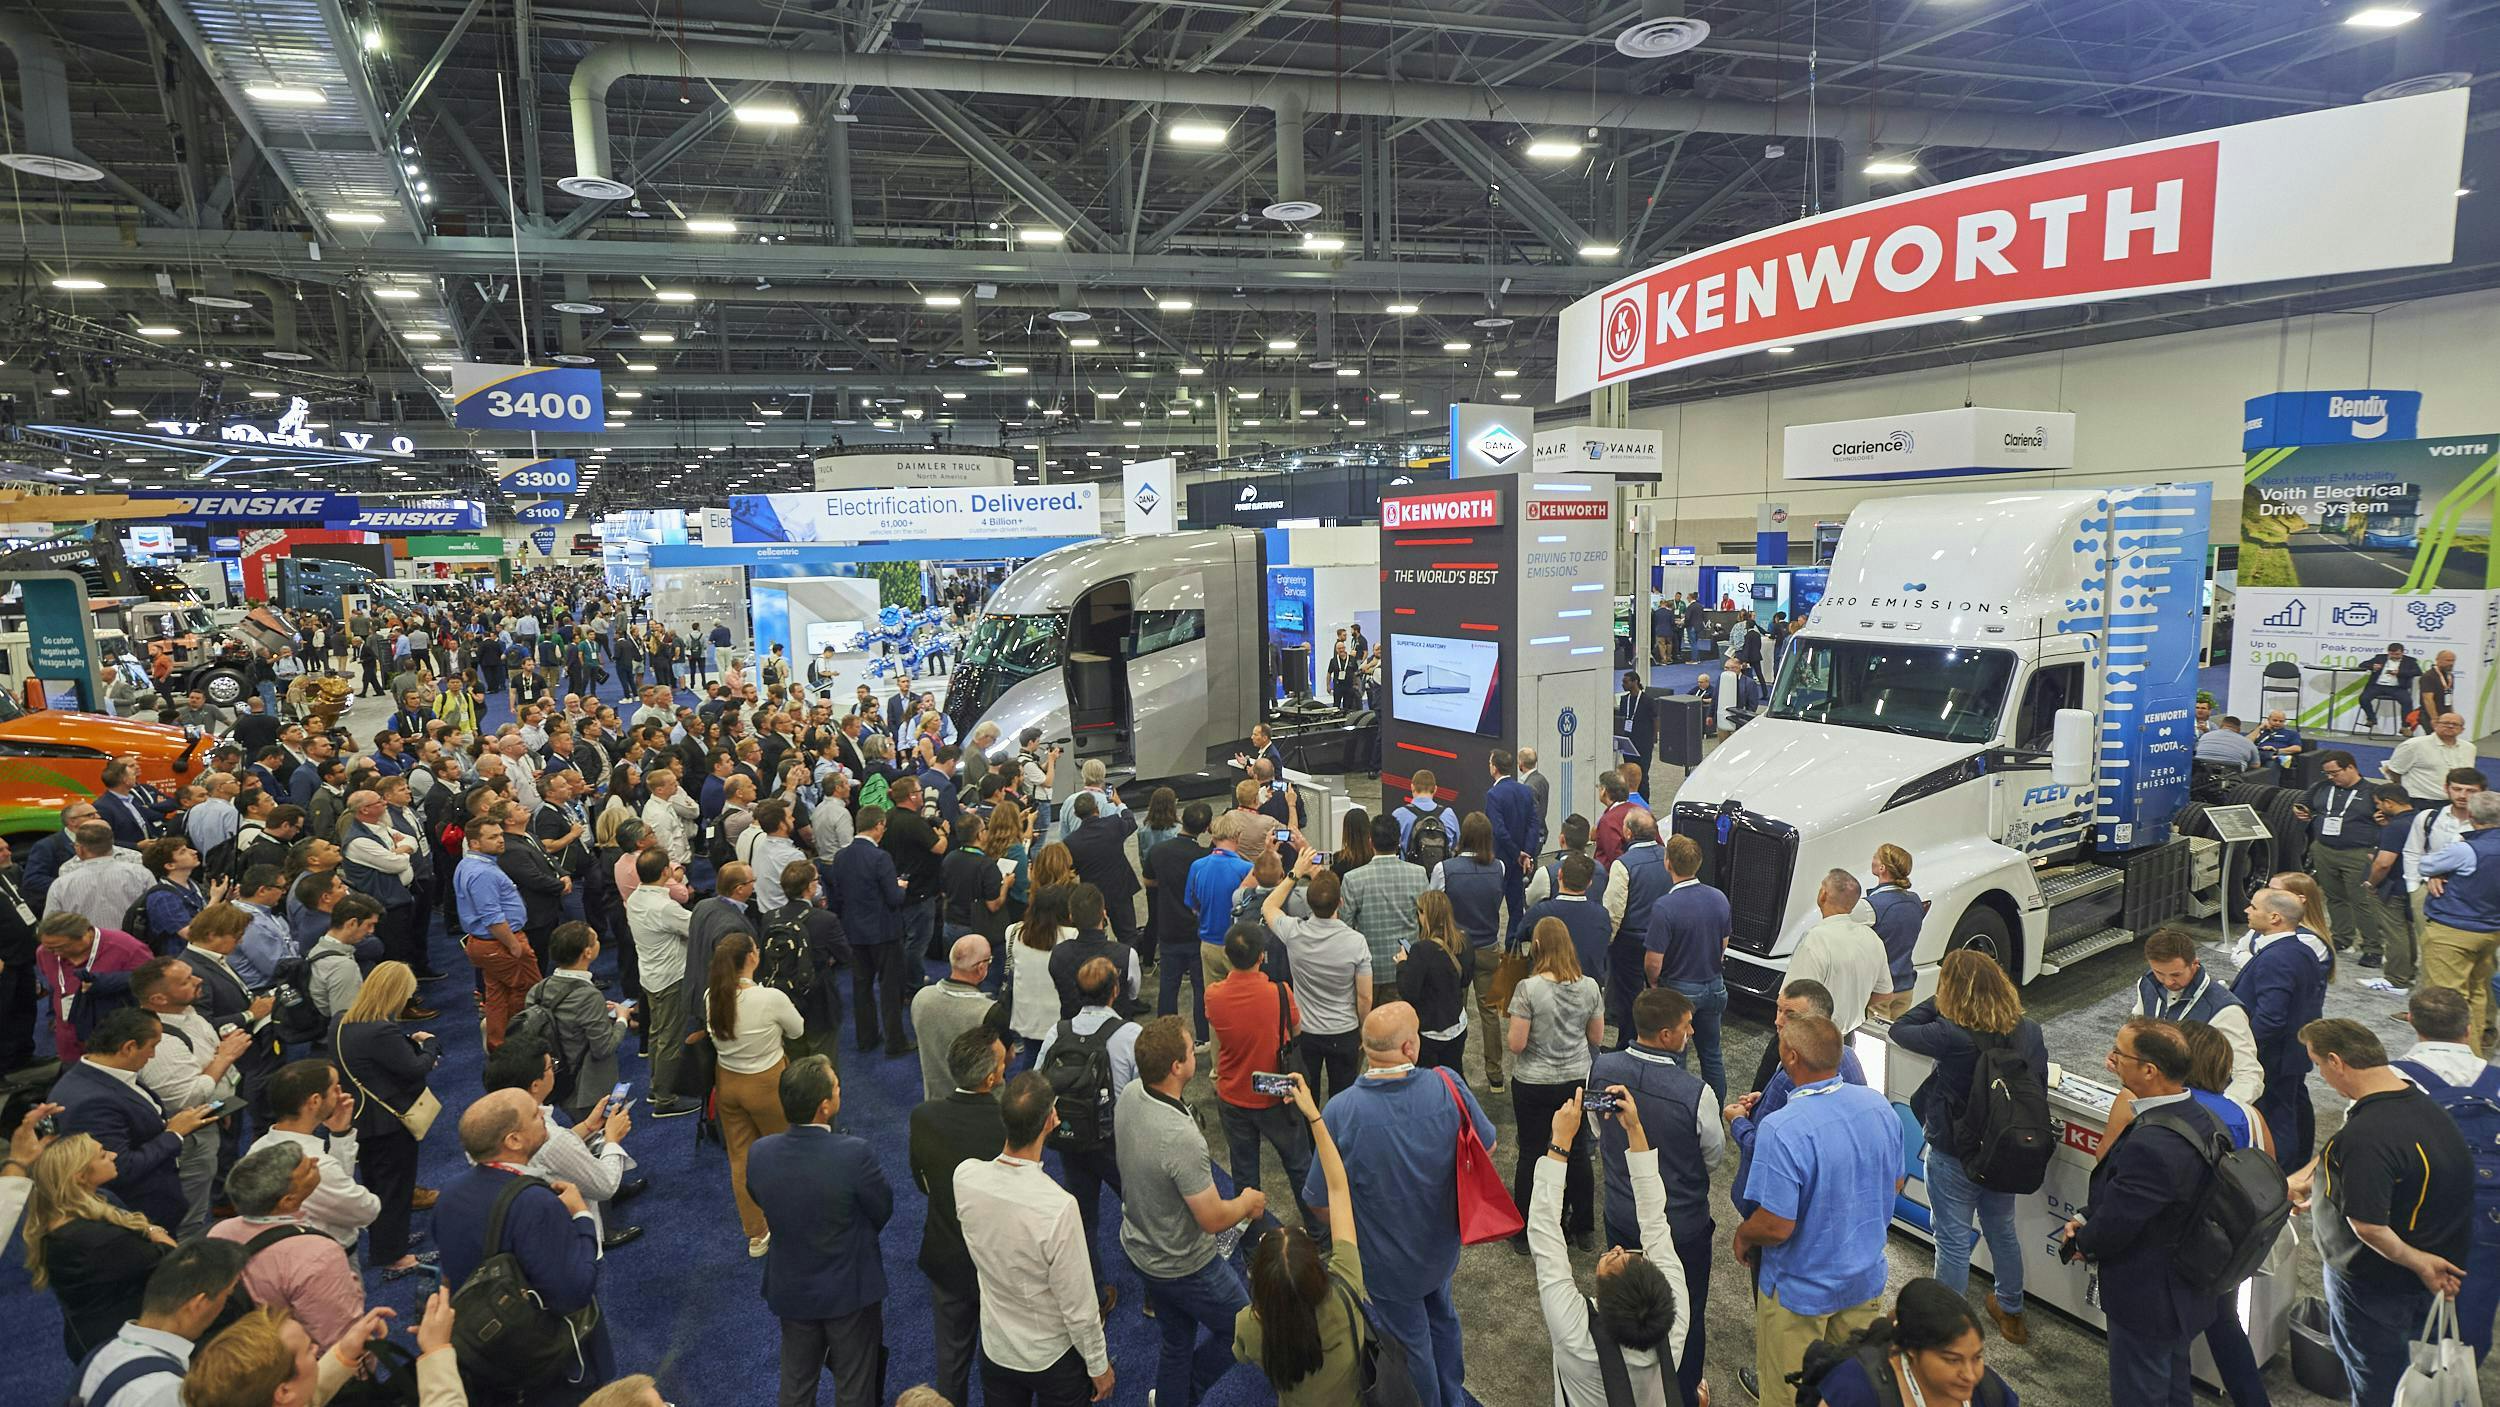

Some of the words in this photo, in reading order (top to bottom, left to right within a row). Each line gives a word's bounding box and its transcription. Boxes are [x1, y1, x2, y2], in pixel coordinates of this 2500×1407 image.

[1656, 178, 2184, 345] KENWORTH
[487, 390, 592, 420] 3400
[2328, 395, 2388, 418] Bendix
[1485, 441, 1513, 450] DANA
[2004, 433, 2043, 447] Clarience
[1610, 443, 1654, 453] VANAIR
[1832, 440, 1903, 456] Clarience
[2428, 444, 2489, 457] VOITH
[897, 462, 946, 470] DAIMLER
[952, 463, 981, 471] TRUCK
[515, 472, 571, 487] 3300
[2261, 476, 2290, 485] Next
[2330, 471, 2397, 483] E-Mobility
[2260, 487, 2307, 501] Voith
[2313, 483, 2408, 499] Electrical
[827, 495, 963, 516] Electrification.
[1138, 495, 1155, 504] DANA
[526, 508, 560, 518] 3100
[1401, 500, 1493, 522] KENWORTH
[1541, 504, 1606, 516] KENWORTH
[2259, 503, 2308, 516] Drive
[2314, 502, 2389, 518] System
[350, 512, 459, 526] PENSKE
[880, 520, 913, 528] 61,000+
[981, 518, 987, 526] 4
[989, 517, 1024, 526] Billion+
[49, 550, 90, 564] VOLVO
[756, 547, 800, 556] cellcentric
[1527, 552, 1567, 565] DRIVING
[1569, 552, 1582, 562] TO
[1583, 550, 1608, 562] ZERO
[1394, 569, 1415, 583] THE
[1416, 570, 1466, 584] WORLD'S
[1468, 571, 1499, 584] BEST
[1527, 565, 1578, 579] EMISSIONS
[1277, 574, 1307, 587] Engineering
[1284, 586, 1307, 597] Services
[1819, 597, 1857, 607] ERO
[1872, 597, 2009, 615] EMISSIONS
[43, 636, 51, 644] Go
[52, 636, 74, 645] carbon
[40, 647, 67, 657] negative
[66, 647, 80, 655] with
[2321, 643, 2347, 652] Peak
[2350, 646, 2385, 654] power
[38, 658, 66, 668] Hexagon
[66, 659, 85, 668] Agility
[2144, 709, 2188, 724] KENWORTH
[2149, 741, 2179, 753] TOYOTA
[2150, 766, 2175, 778] ZERO
[2023, 783, 2072, 806] FCEV
